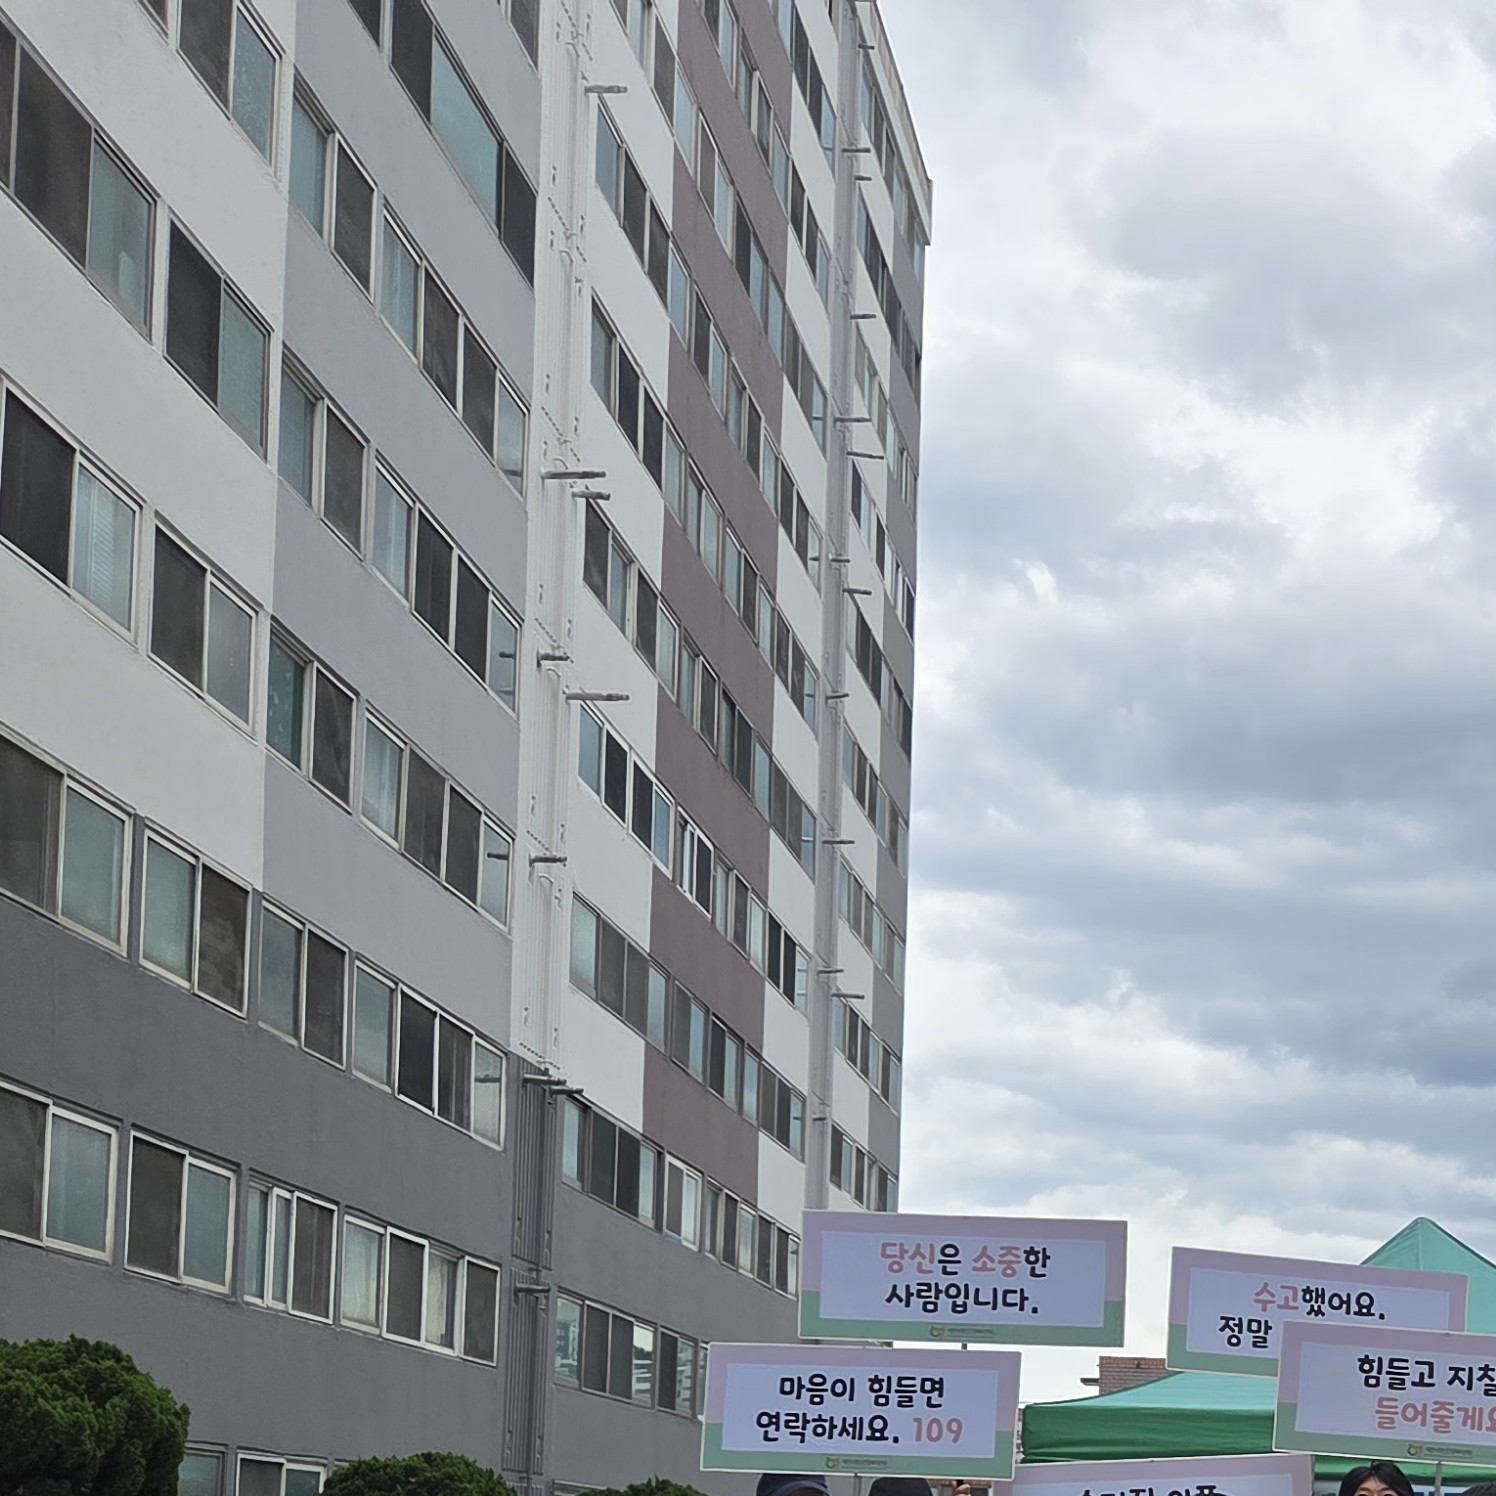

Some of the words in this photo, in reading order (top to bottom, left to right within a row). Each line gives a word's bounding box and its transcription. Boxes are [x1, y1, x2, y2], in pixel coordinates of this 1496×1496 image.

[879, 1241, 962, 1277] 당신은
[971, 1245, 1051, 1278] 소중한
[885, 1281, 1039, 1314] 사람입니다.
[1253, 1281, 1386, 1320] 수고했어요.
[1218, 1315, 1273, 1349] 정말
[1357, 1354, 1437, 1391] 힘들고
[778, 1375, 856, 1407] 마음이
[867, 1373, 945, 1409] 힘들면
[755, 1411, 900, 1444] 연락하세요.
[912, 1415, 964, 1443] 109
